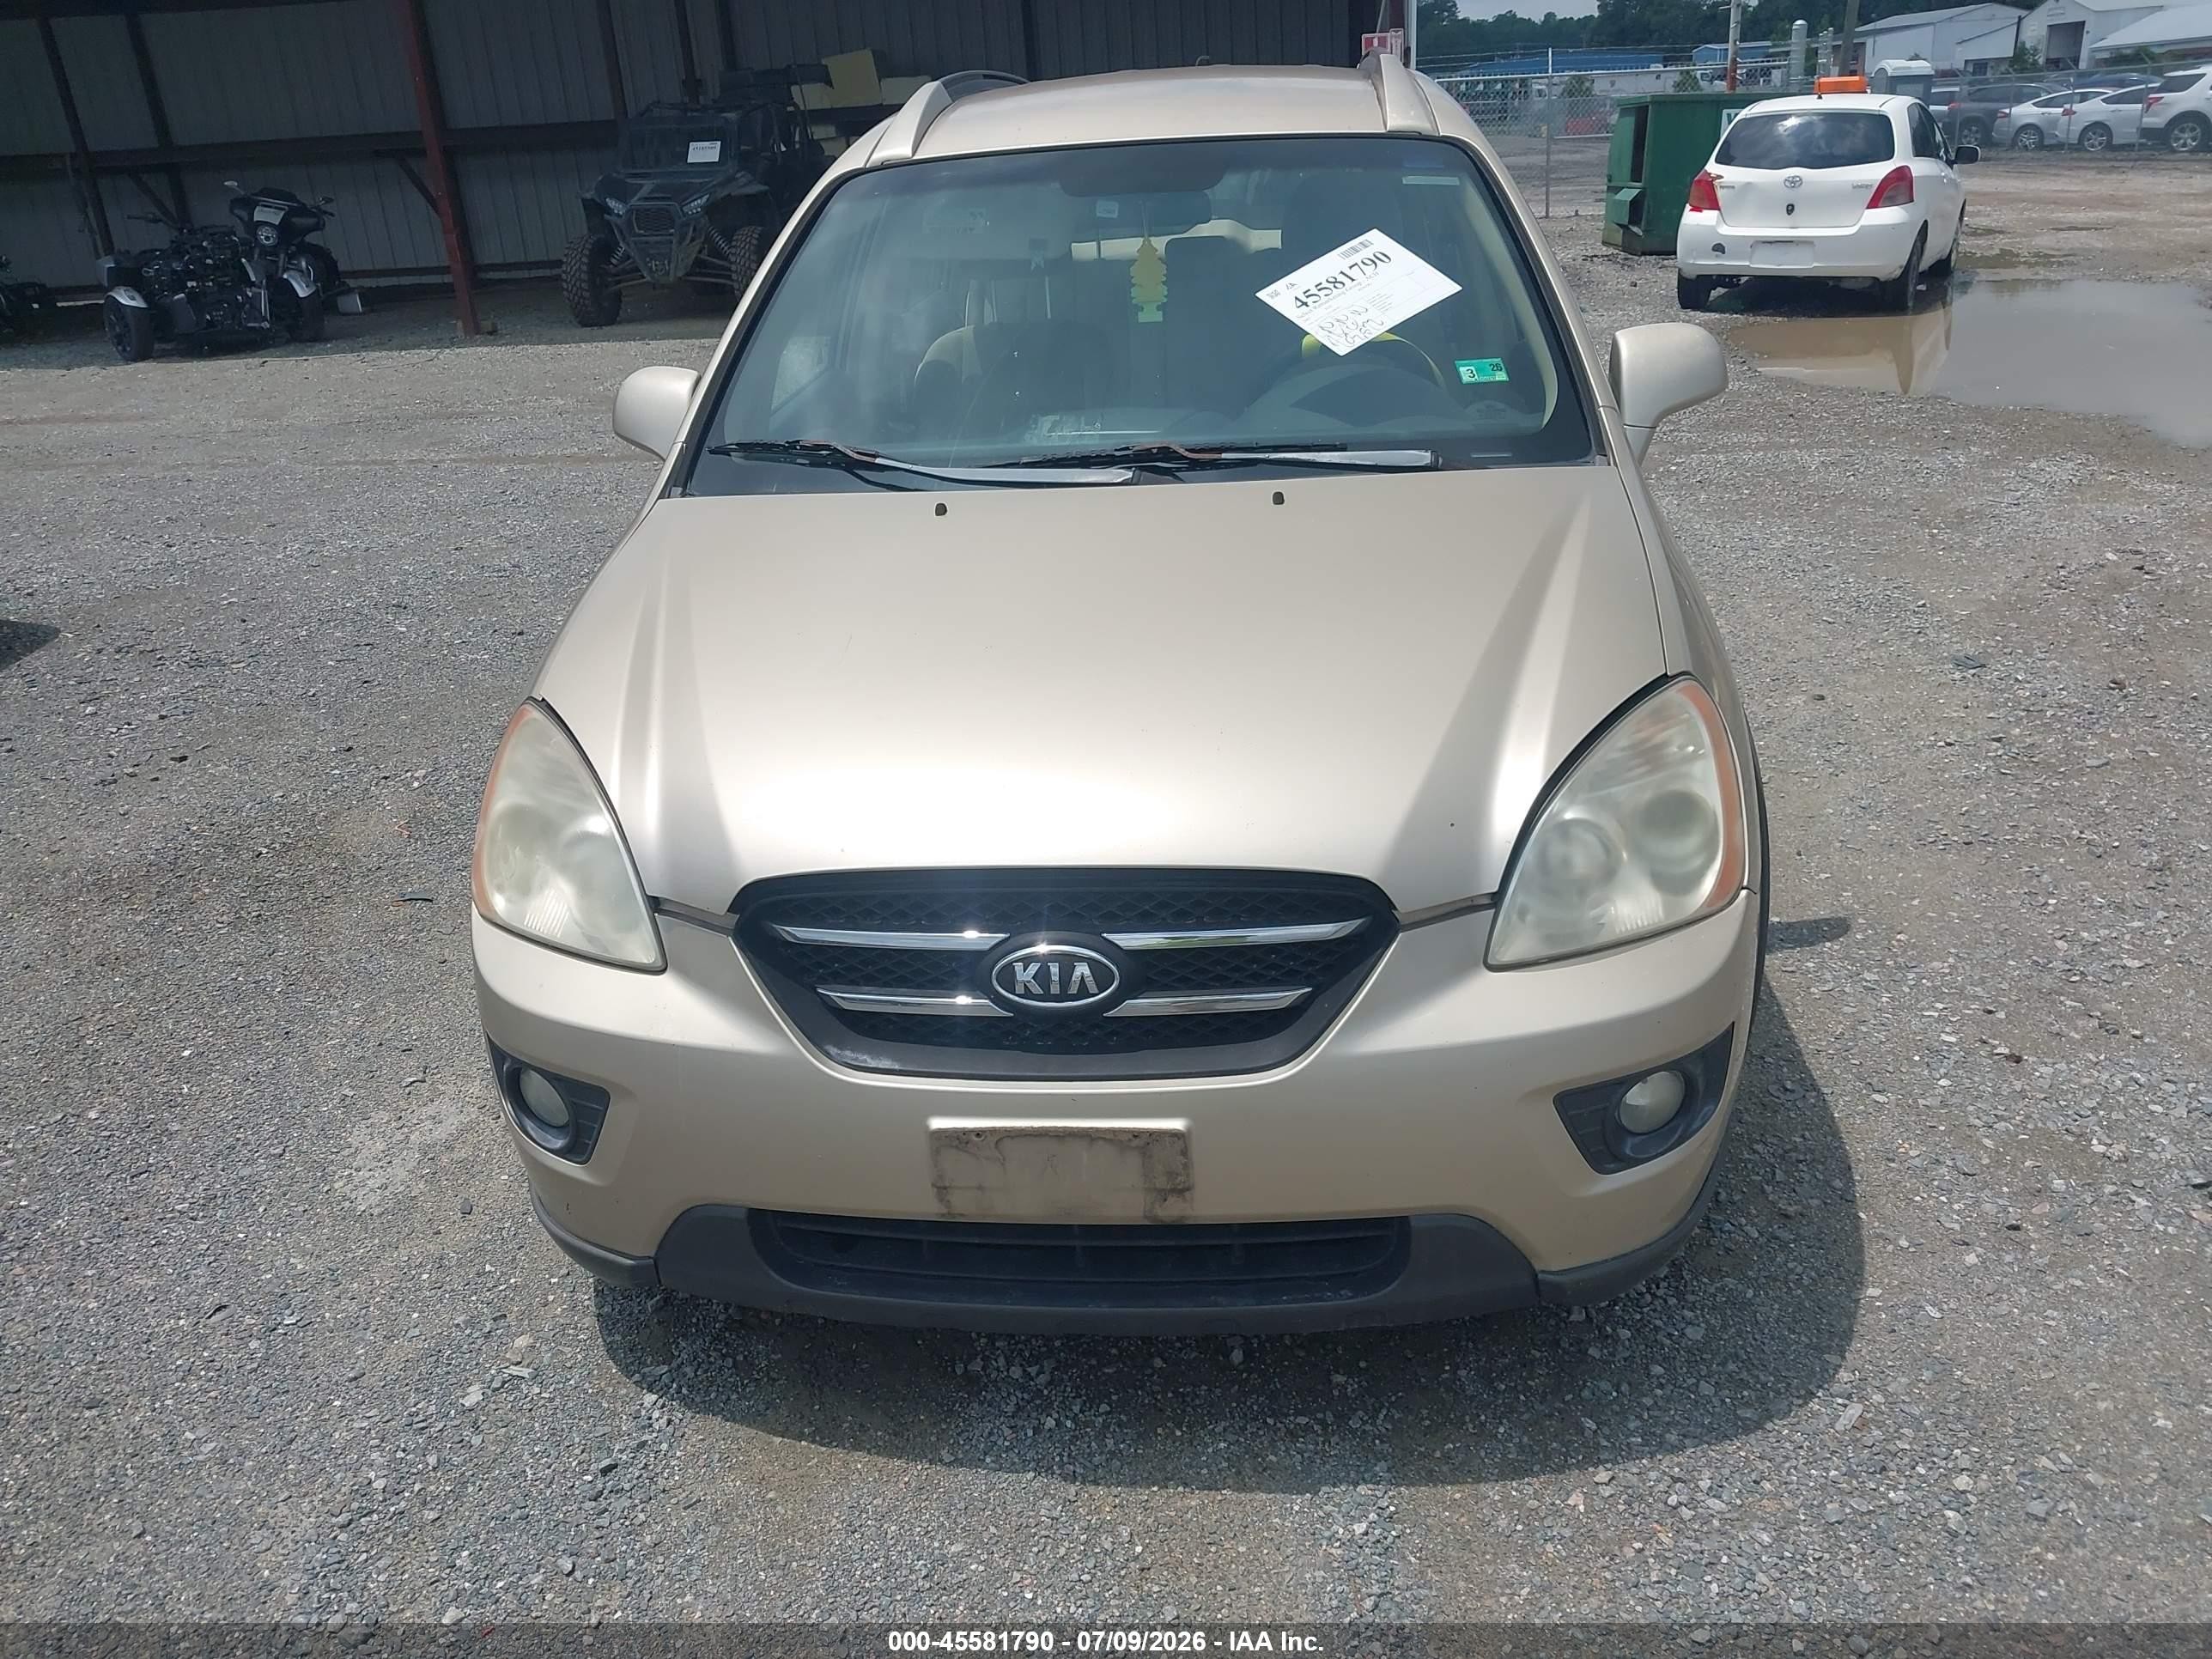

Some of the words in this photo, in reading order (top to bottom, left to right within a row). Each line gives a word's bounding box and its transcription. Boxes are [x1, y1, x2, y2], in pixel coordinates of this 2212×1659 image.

[1293, 251, 1392, 309] 45581790
[1466, 368, 1476, 379] 3
[1491, 362, 1503, 372] 26
[1012, 962, 1100, 994] KIA
